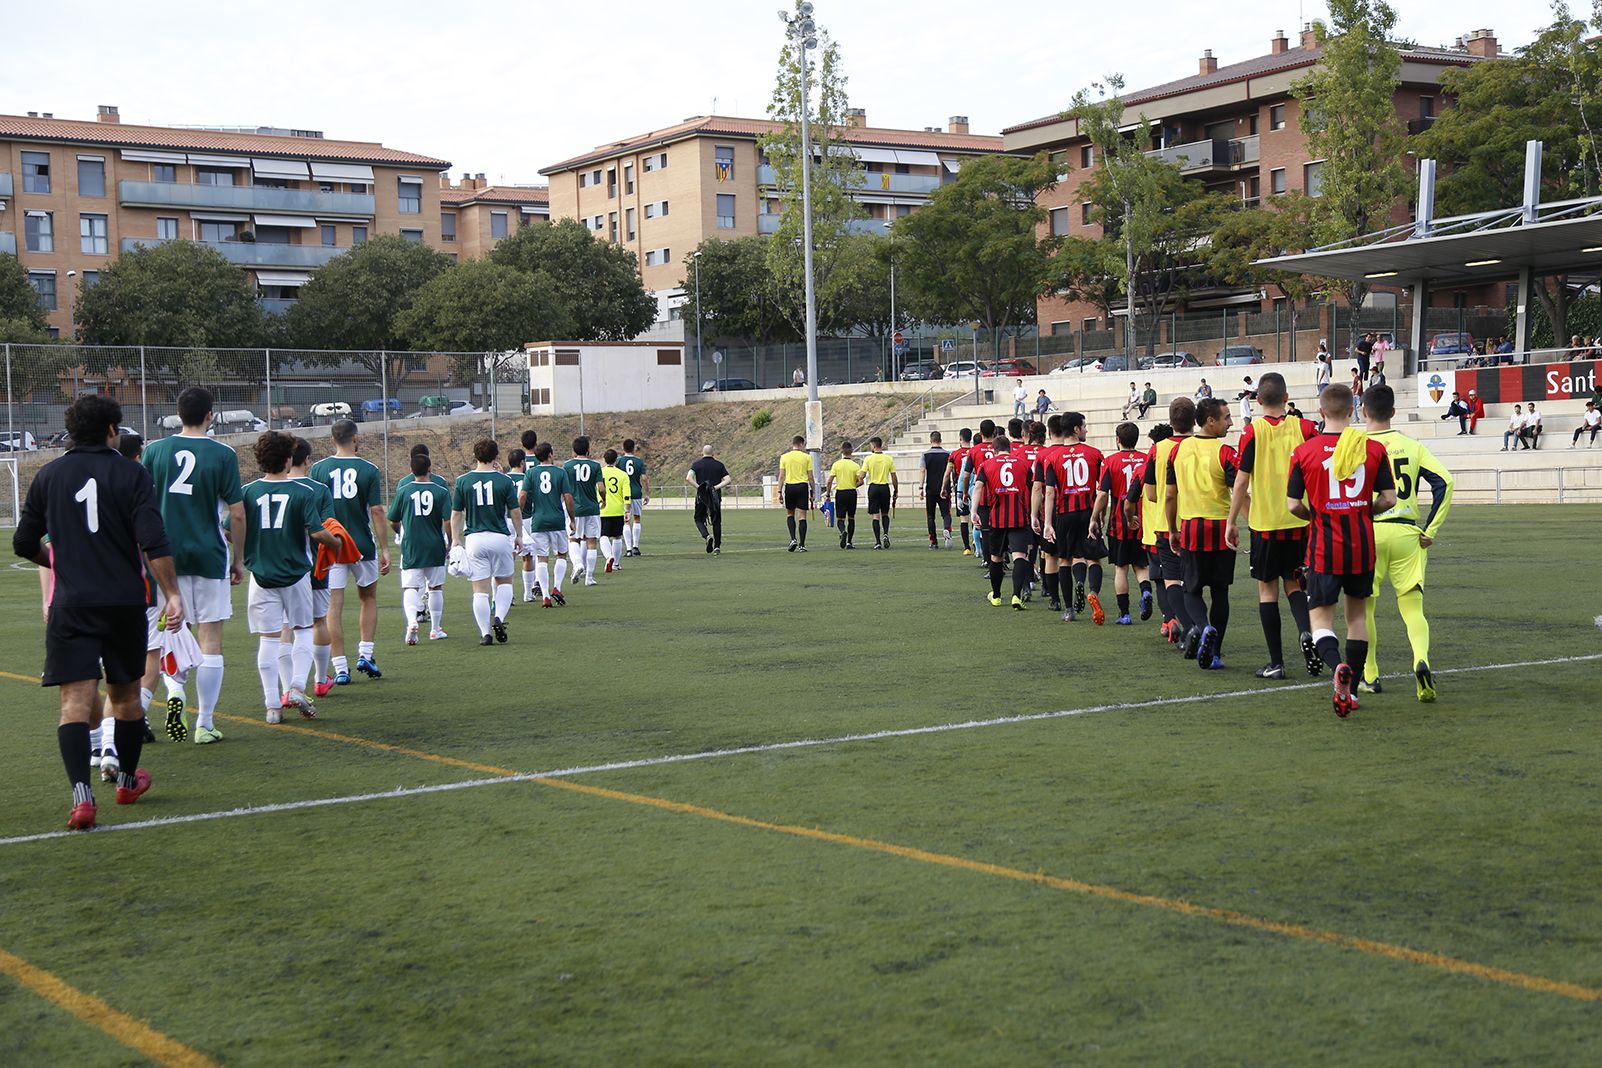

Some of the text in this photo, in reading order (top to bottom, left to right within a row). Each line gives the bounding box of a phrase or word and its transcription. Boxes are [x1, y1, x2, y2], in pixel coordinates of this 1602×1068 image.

[1546, 368, 1596, 394] Sant
[168, 449, 196, 495] 2
[573, 463, 591, 482] 10
[625, 459, 635, 476] 6
[999, 462, 1014, 487] 6
[1062, 457, 1089, 487] 10
[1321, 455, 1366, 500] 19
[329, 467, 358, 499] 18
[472, 480, 494, 506] 11
[540, 471, 552, 494] 8
[608, 476, 619, 494] 3
[75, 477, 99, 533] 1
[256, 493, 290, 529] 17
[410, 490, 434, 516] 19
